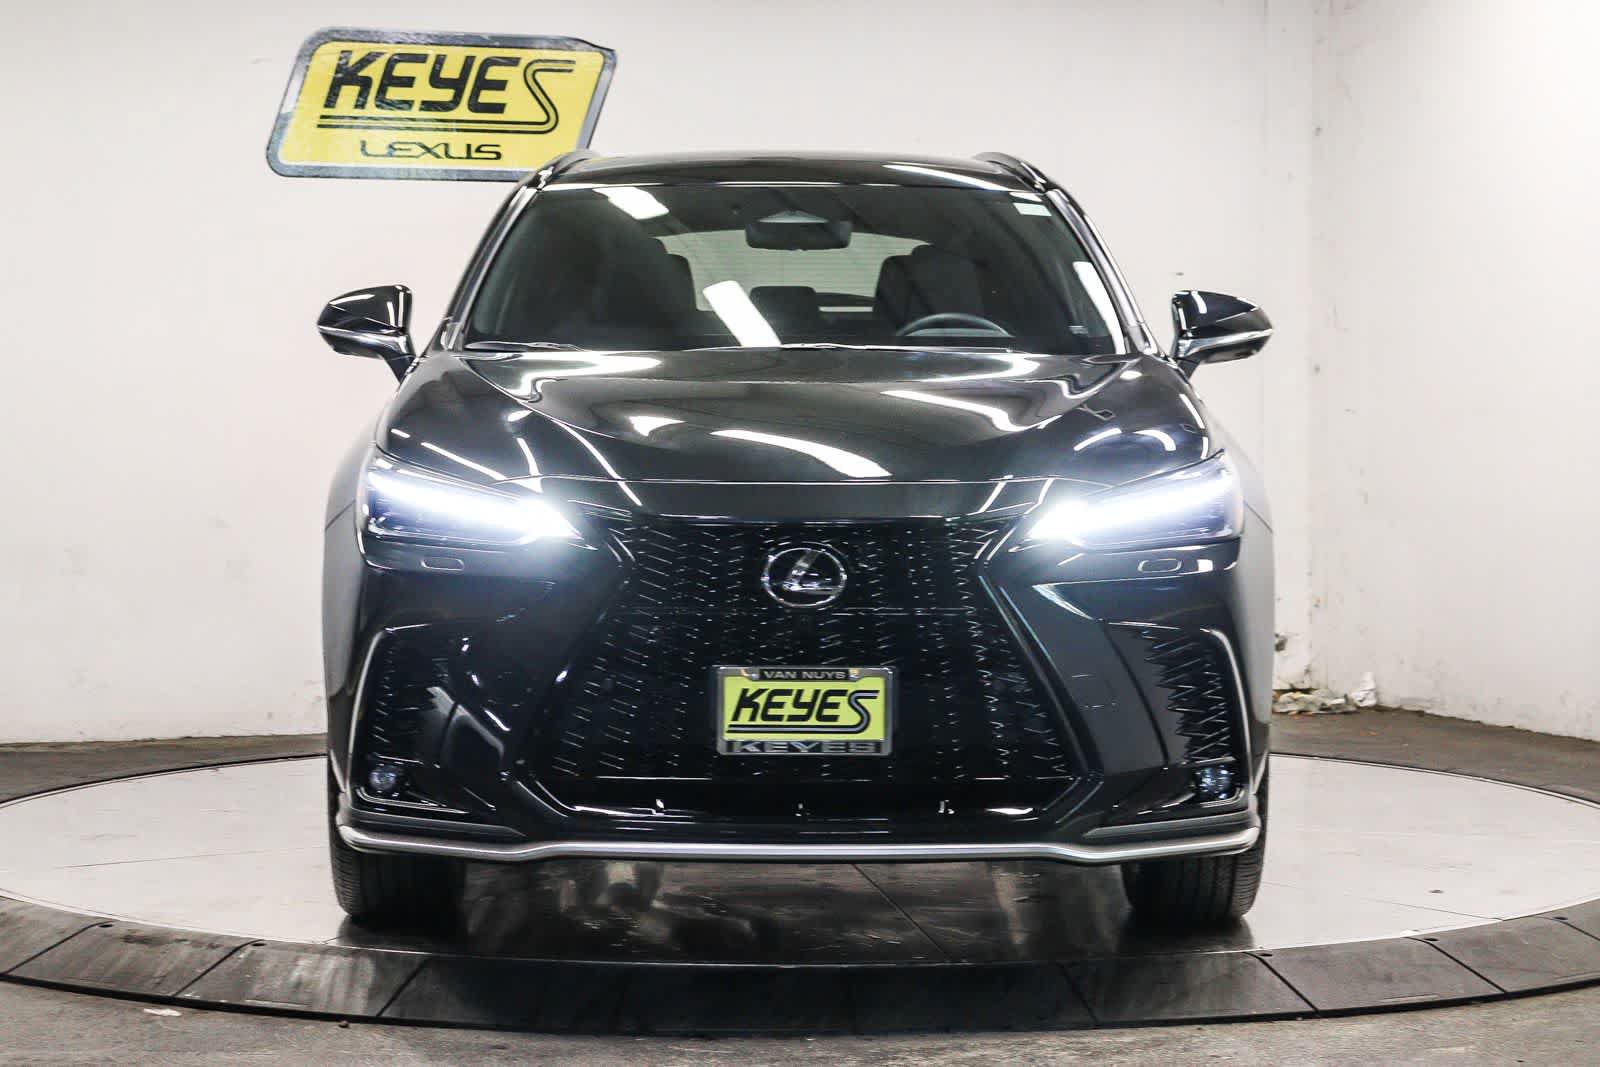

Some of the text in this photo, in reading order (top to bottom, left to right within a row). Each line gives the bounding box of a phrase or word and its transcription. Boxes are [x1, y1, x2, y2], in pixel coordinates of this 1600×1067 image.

[319, 50, 576, 134] KEYES
[360, 140, 502, 160] LEXUS
[763, 671, 846, 680] VAN NUYS
[727, 688, 880, 734] KEYES
[734, 741, 875, 753] KEYES
